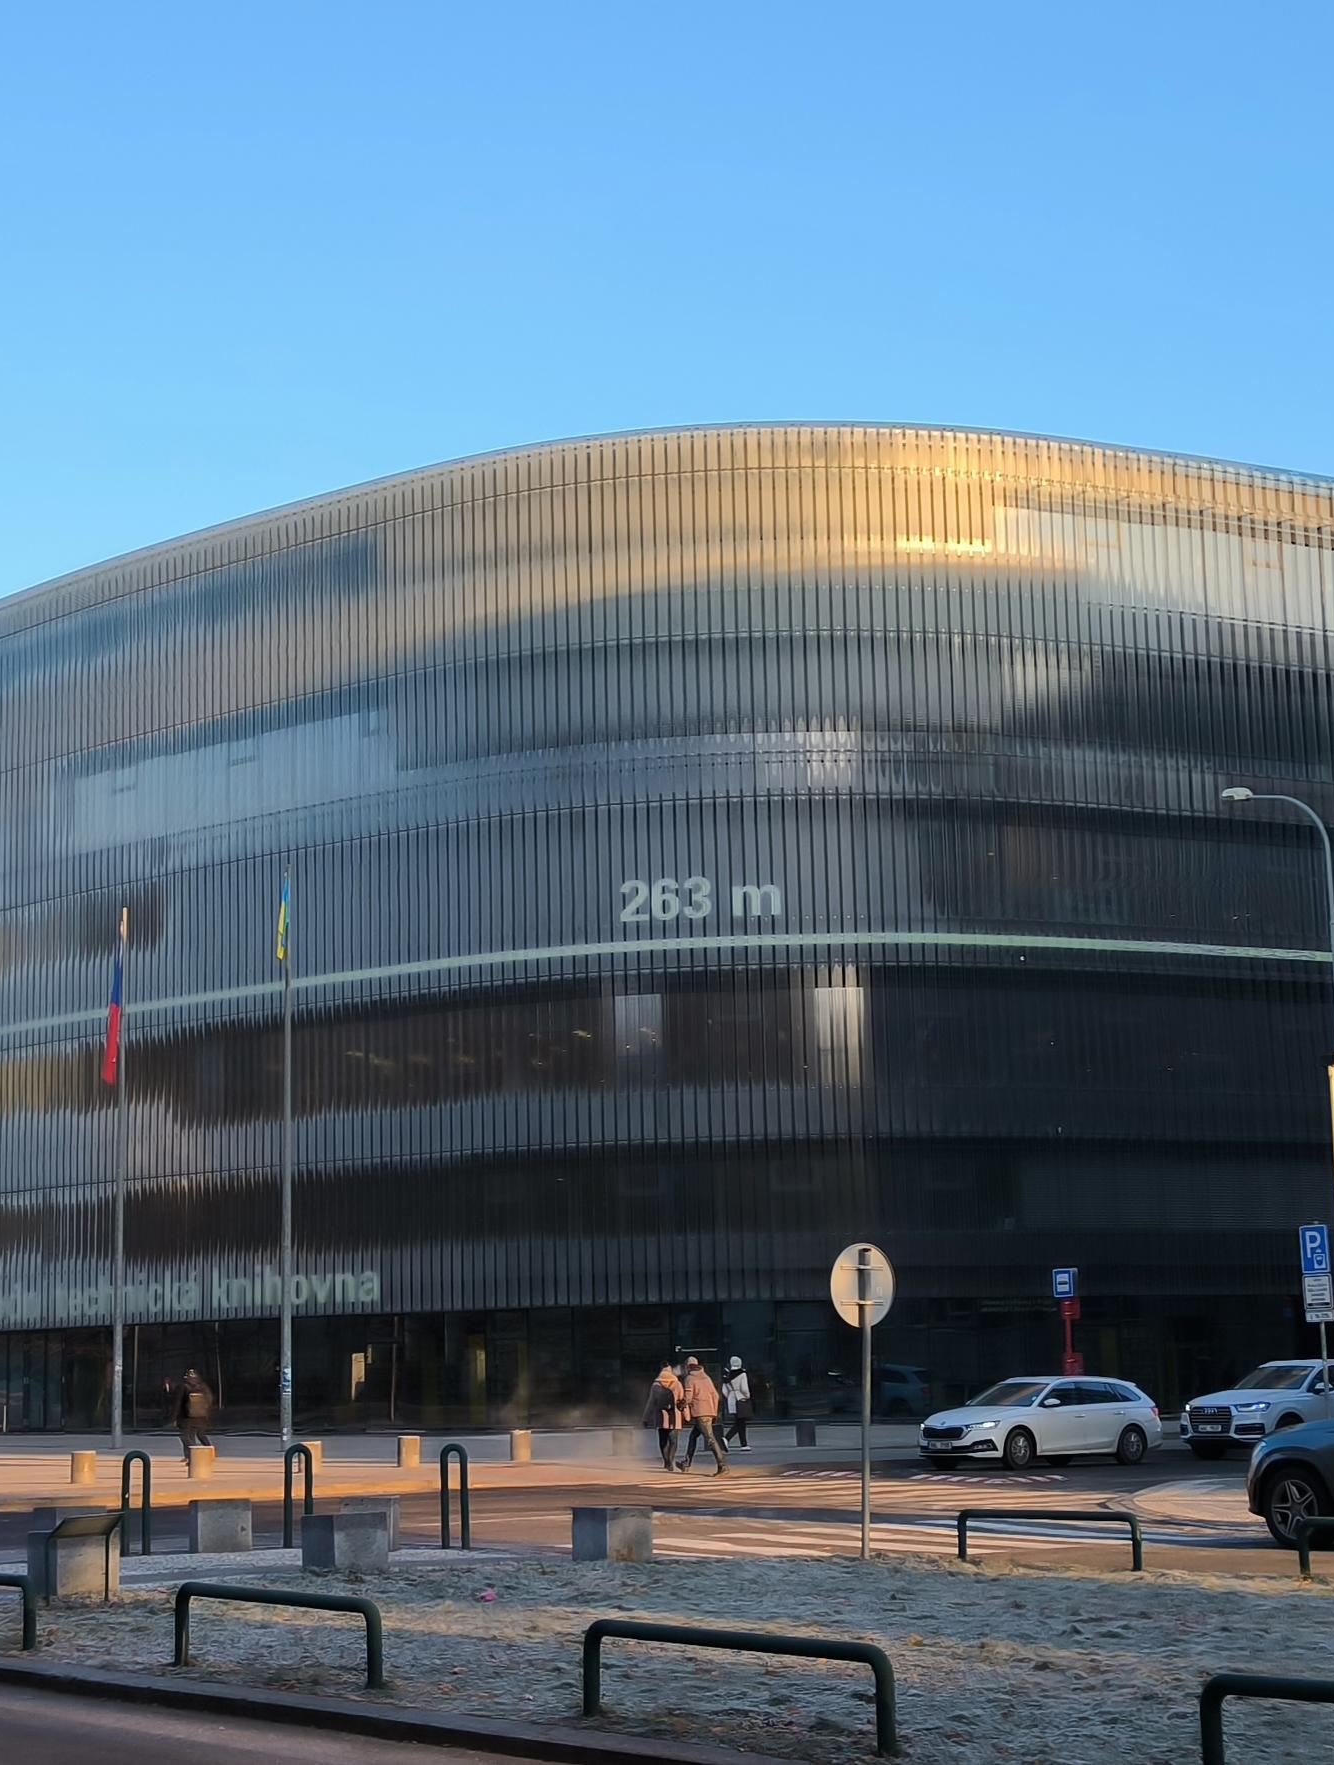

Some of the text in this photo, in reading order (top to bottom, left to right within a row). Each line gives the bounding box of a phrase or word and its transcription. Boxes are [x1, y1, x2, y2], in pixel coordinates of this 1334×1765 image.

[619, 876, 782, 923] 263 m
[1305, 1231, 1321, 1258] P
[212, 1265, 381, 1308] knihovna
